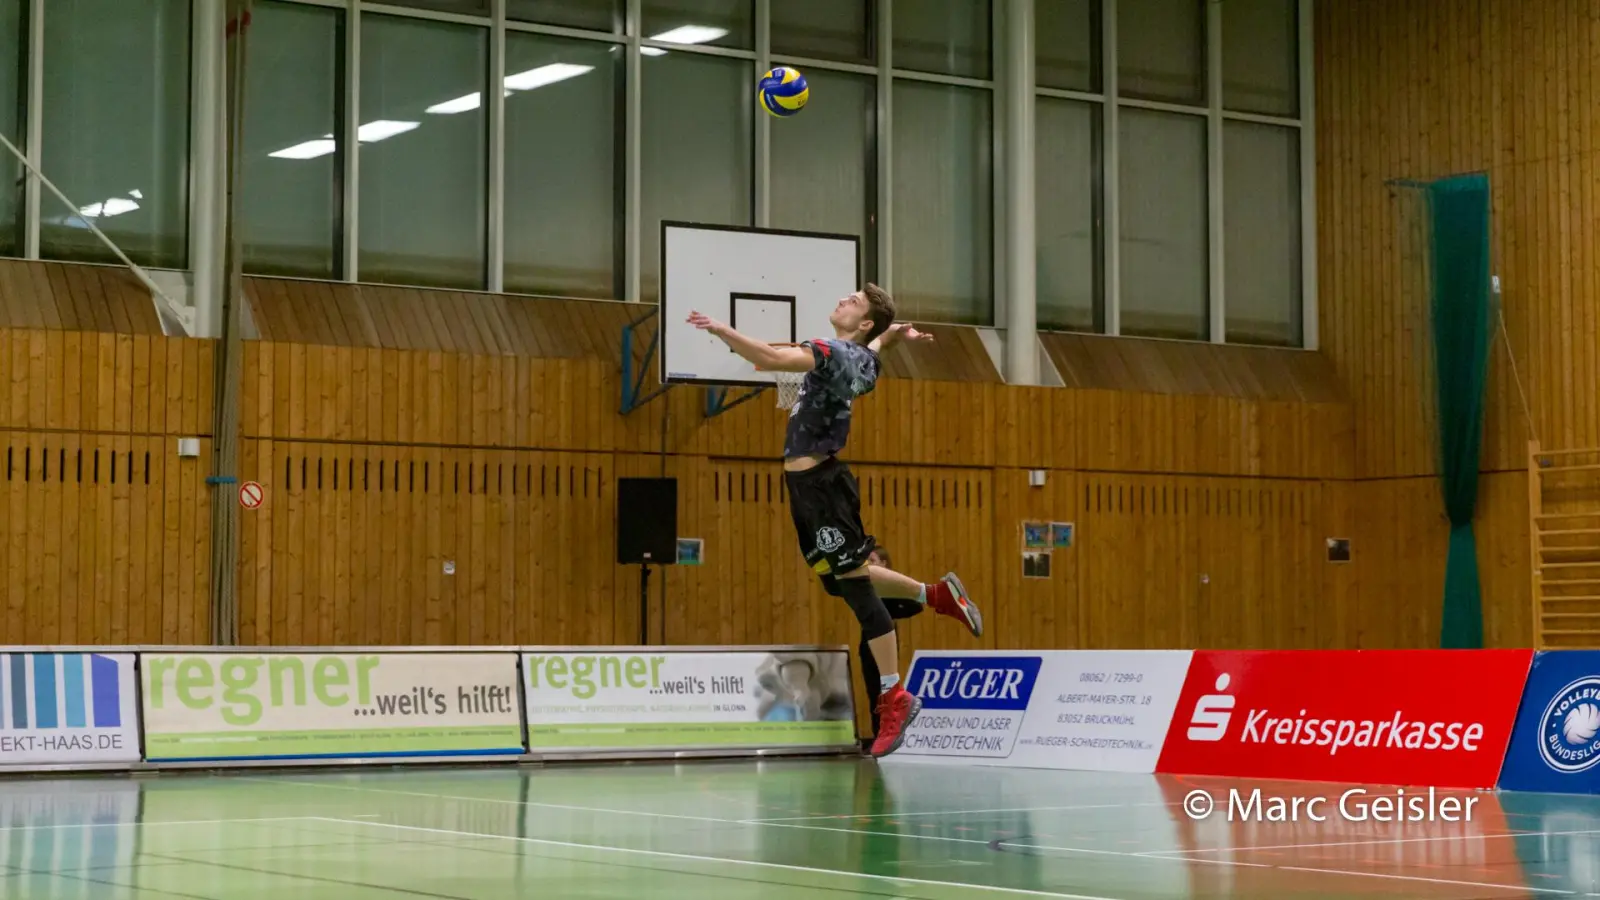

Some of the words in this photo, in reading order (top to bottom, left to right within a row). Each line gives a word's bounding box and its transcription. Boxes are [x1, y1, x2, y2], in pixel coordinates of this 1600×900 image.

[149, 654, 380, 726] regner
[529, 655, 666, 699] regner
[711, 676, 745, 694] hilft!
[915, 661, 1025, 699] RÜGER
[457, 685, 512, 714] hilft!
[910, 716, 953, 729] UTOGEN
[956, 716, 979, 728] UND
[981, 717, 1012, 731] LASER
[1240, 708, 1484, 756] Kreissparkasse
[1, 734, 123, 752] EKT-HAAS.DE
